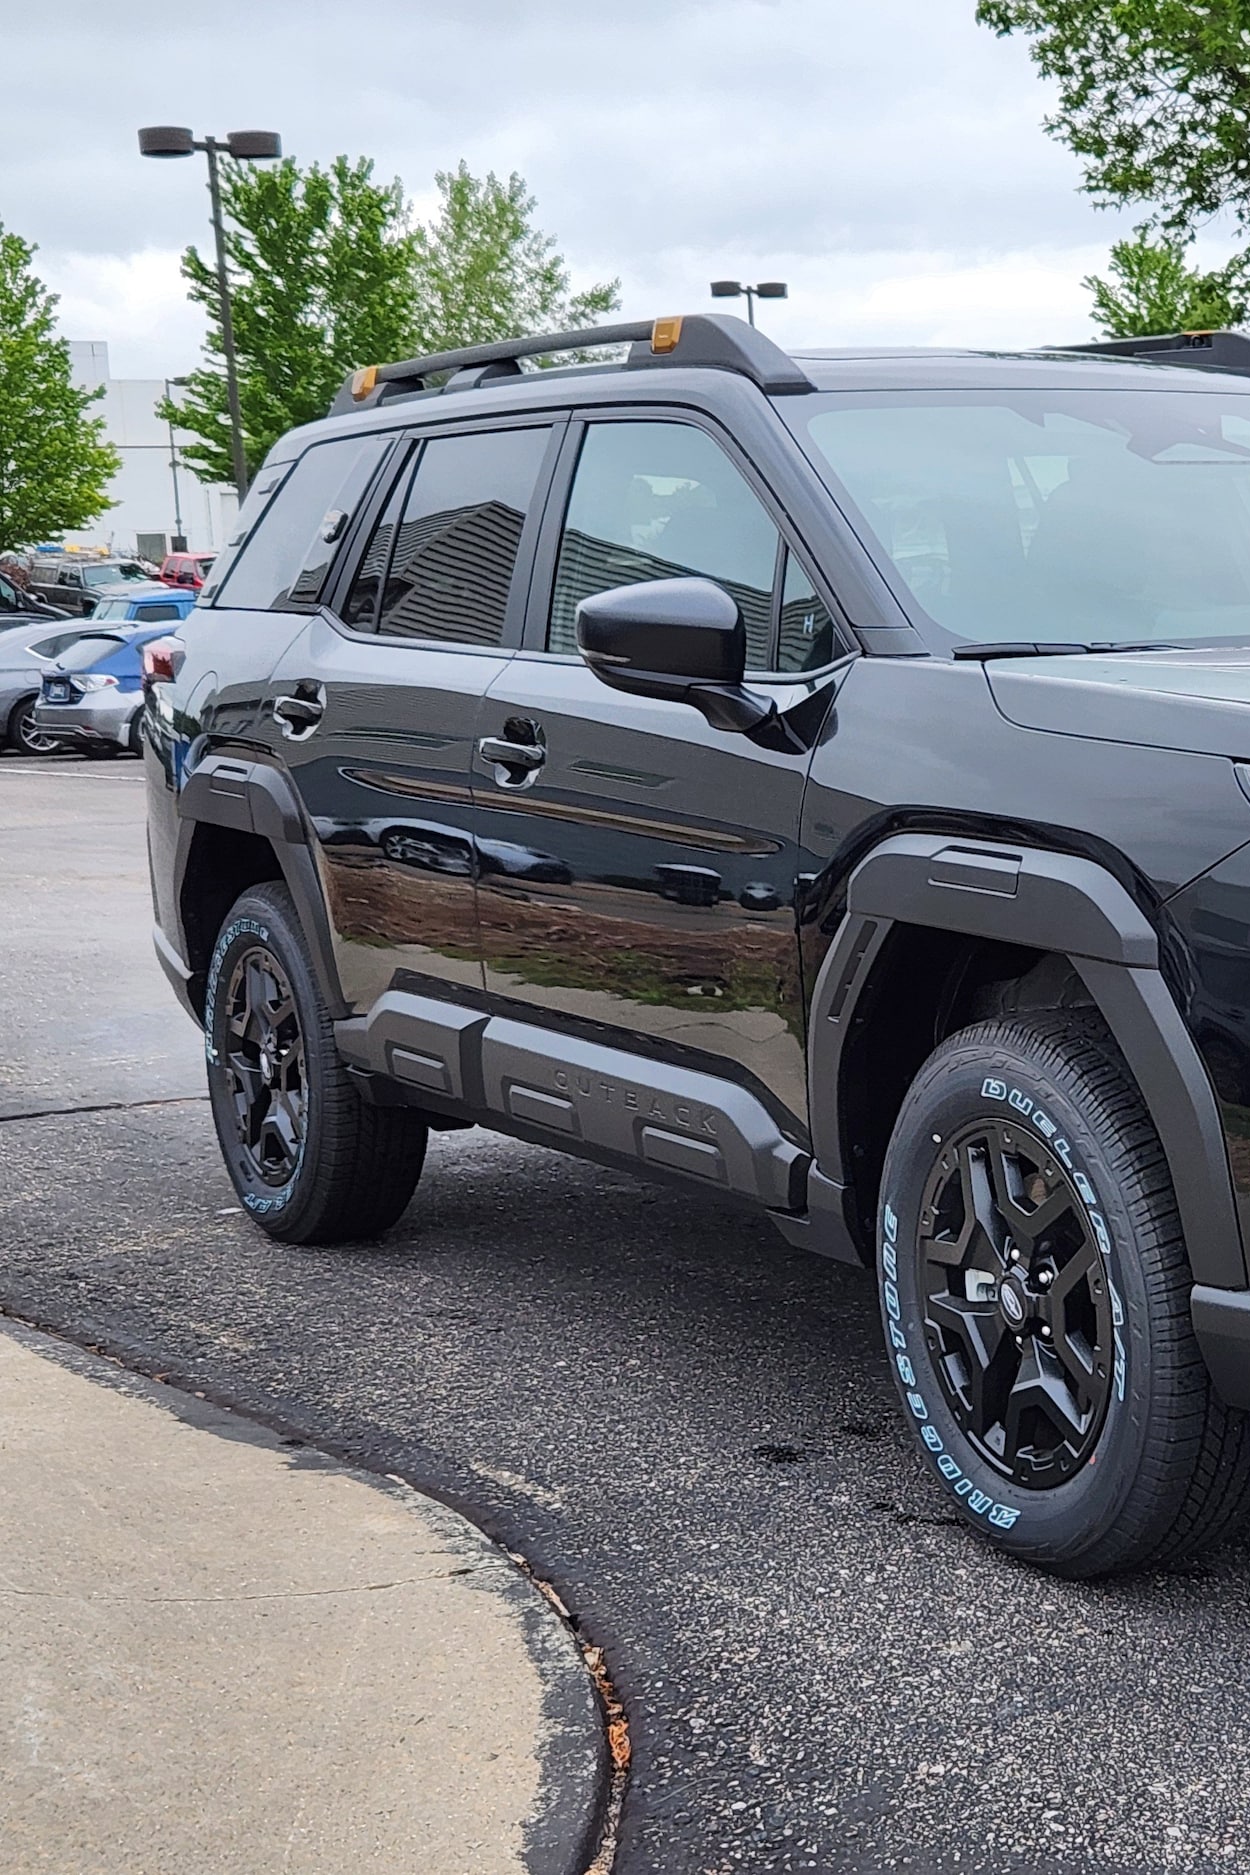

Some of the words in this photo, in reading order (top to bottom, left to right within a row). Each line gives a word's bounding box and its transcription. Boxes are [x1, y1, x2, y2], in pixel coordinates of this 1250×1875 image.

[553, 1069, 717, 1135] OUTBACK
[980, 1078, 1110, 1254] DUELER
[1107, 1278, 1126, 1402] A/T
[883, 1203, 1021, 1529] BRIDGESTONE
